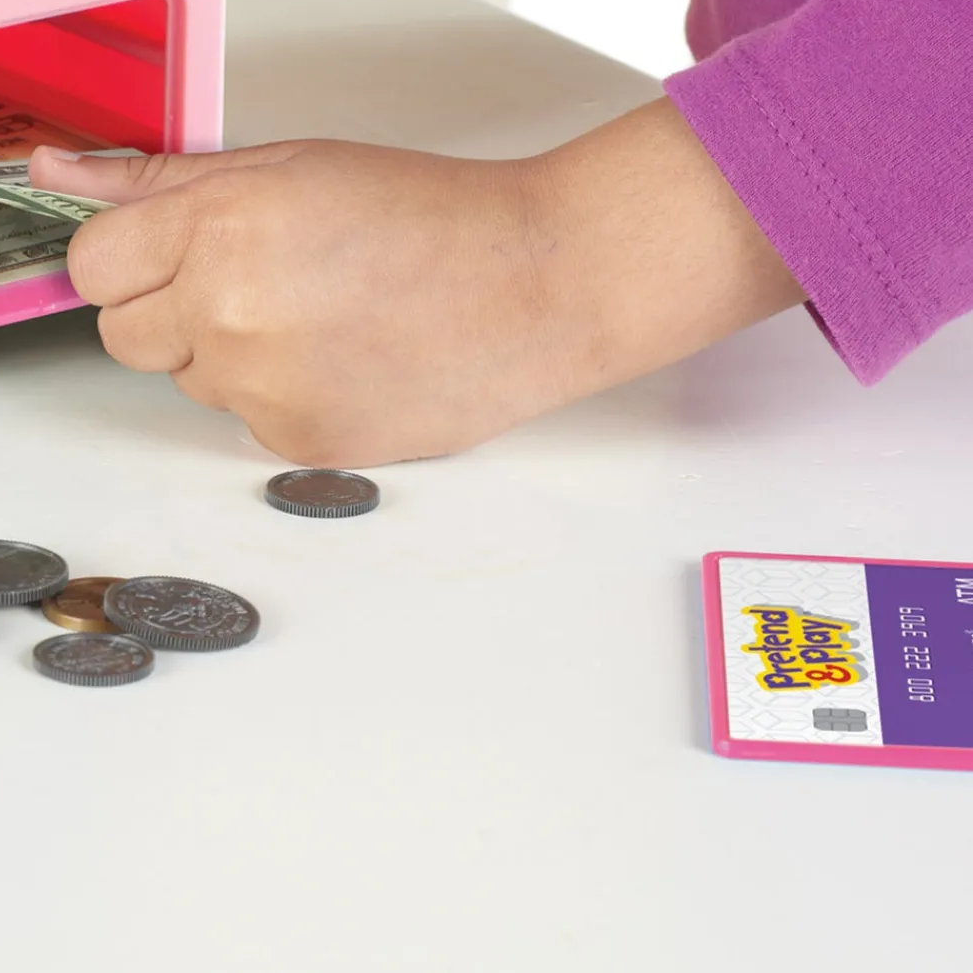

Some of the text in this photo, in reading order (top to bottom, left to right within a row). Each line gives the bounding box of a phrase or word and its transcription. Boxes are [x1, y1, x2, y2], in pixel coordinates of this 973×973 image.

[954, 577, 973, 605] ATM
[748, 608, 812, 689] Pretend
[795, 618, 852, 683] & Play
[898, 606, 935, 703] 800 222 3909
